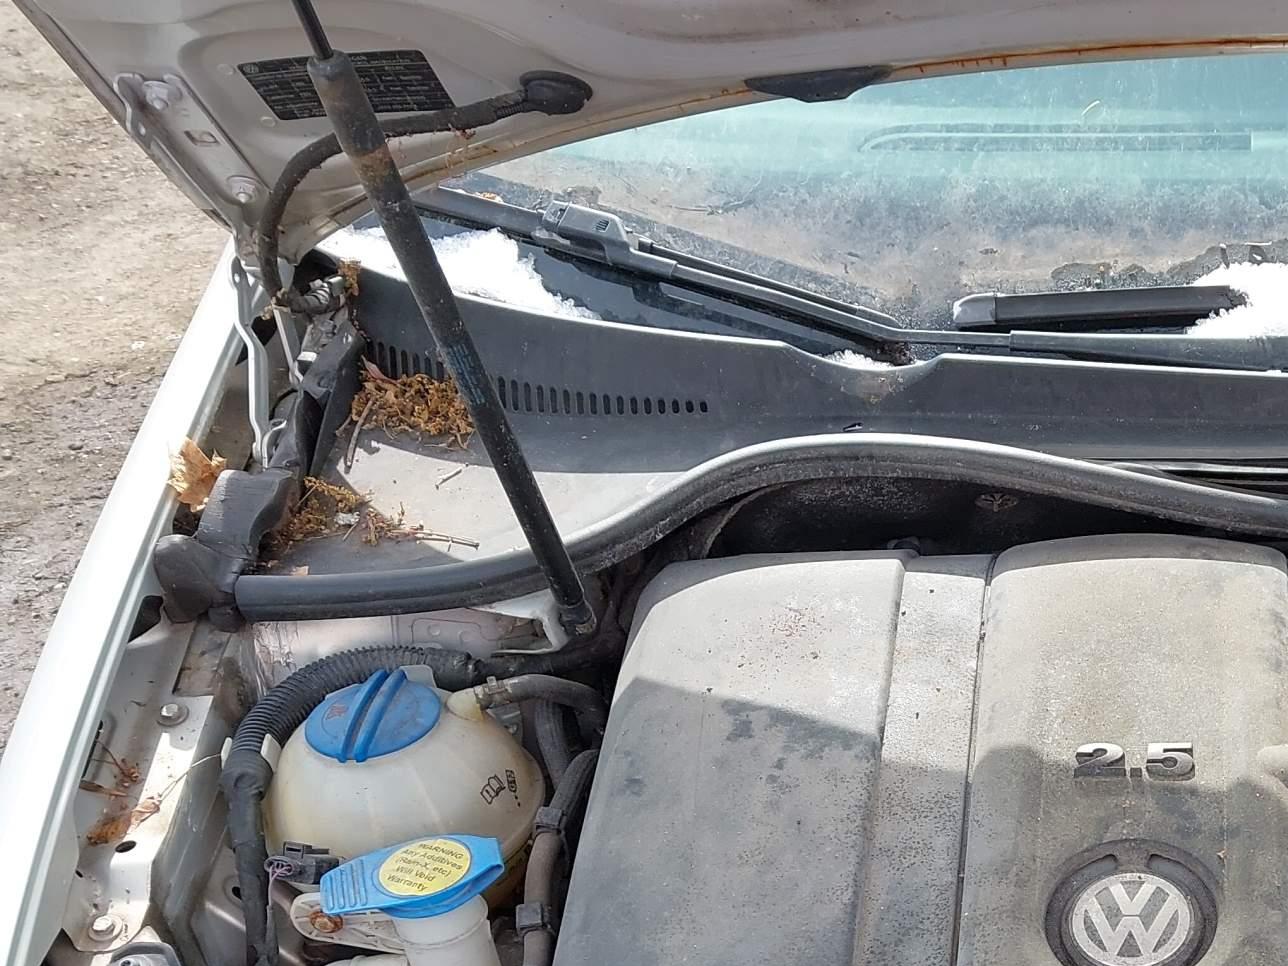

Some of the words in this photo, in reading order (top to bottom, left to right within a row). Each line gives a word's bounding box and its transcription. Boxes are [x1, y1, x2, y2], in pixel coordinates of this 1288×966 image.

[1074, 742, 1196, 782] 2.5
[419, 843, 464, 860] WARNING
[420, 852, 463, 870] Additives
[387, 873, 429, 892] Warranty
[415, 870, 436, 882] Void
